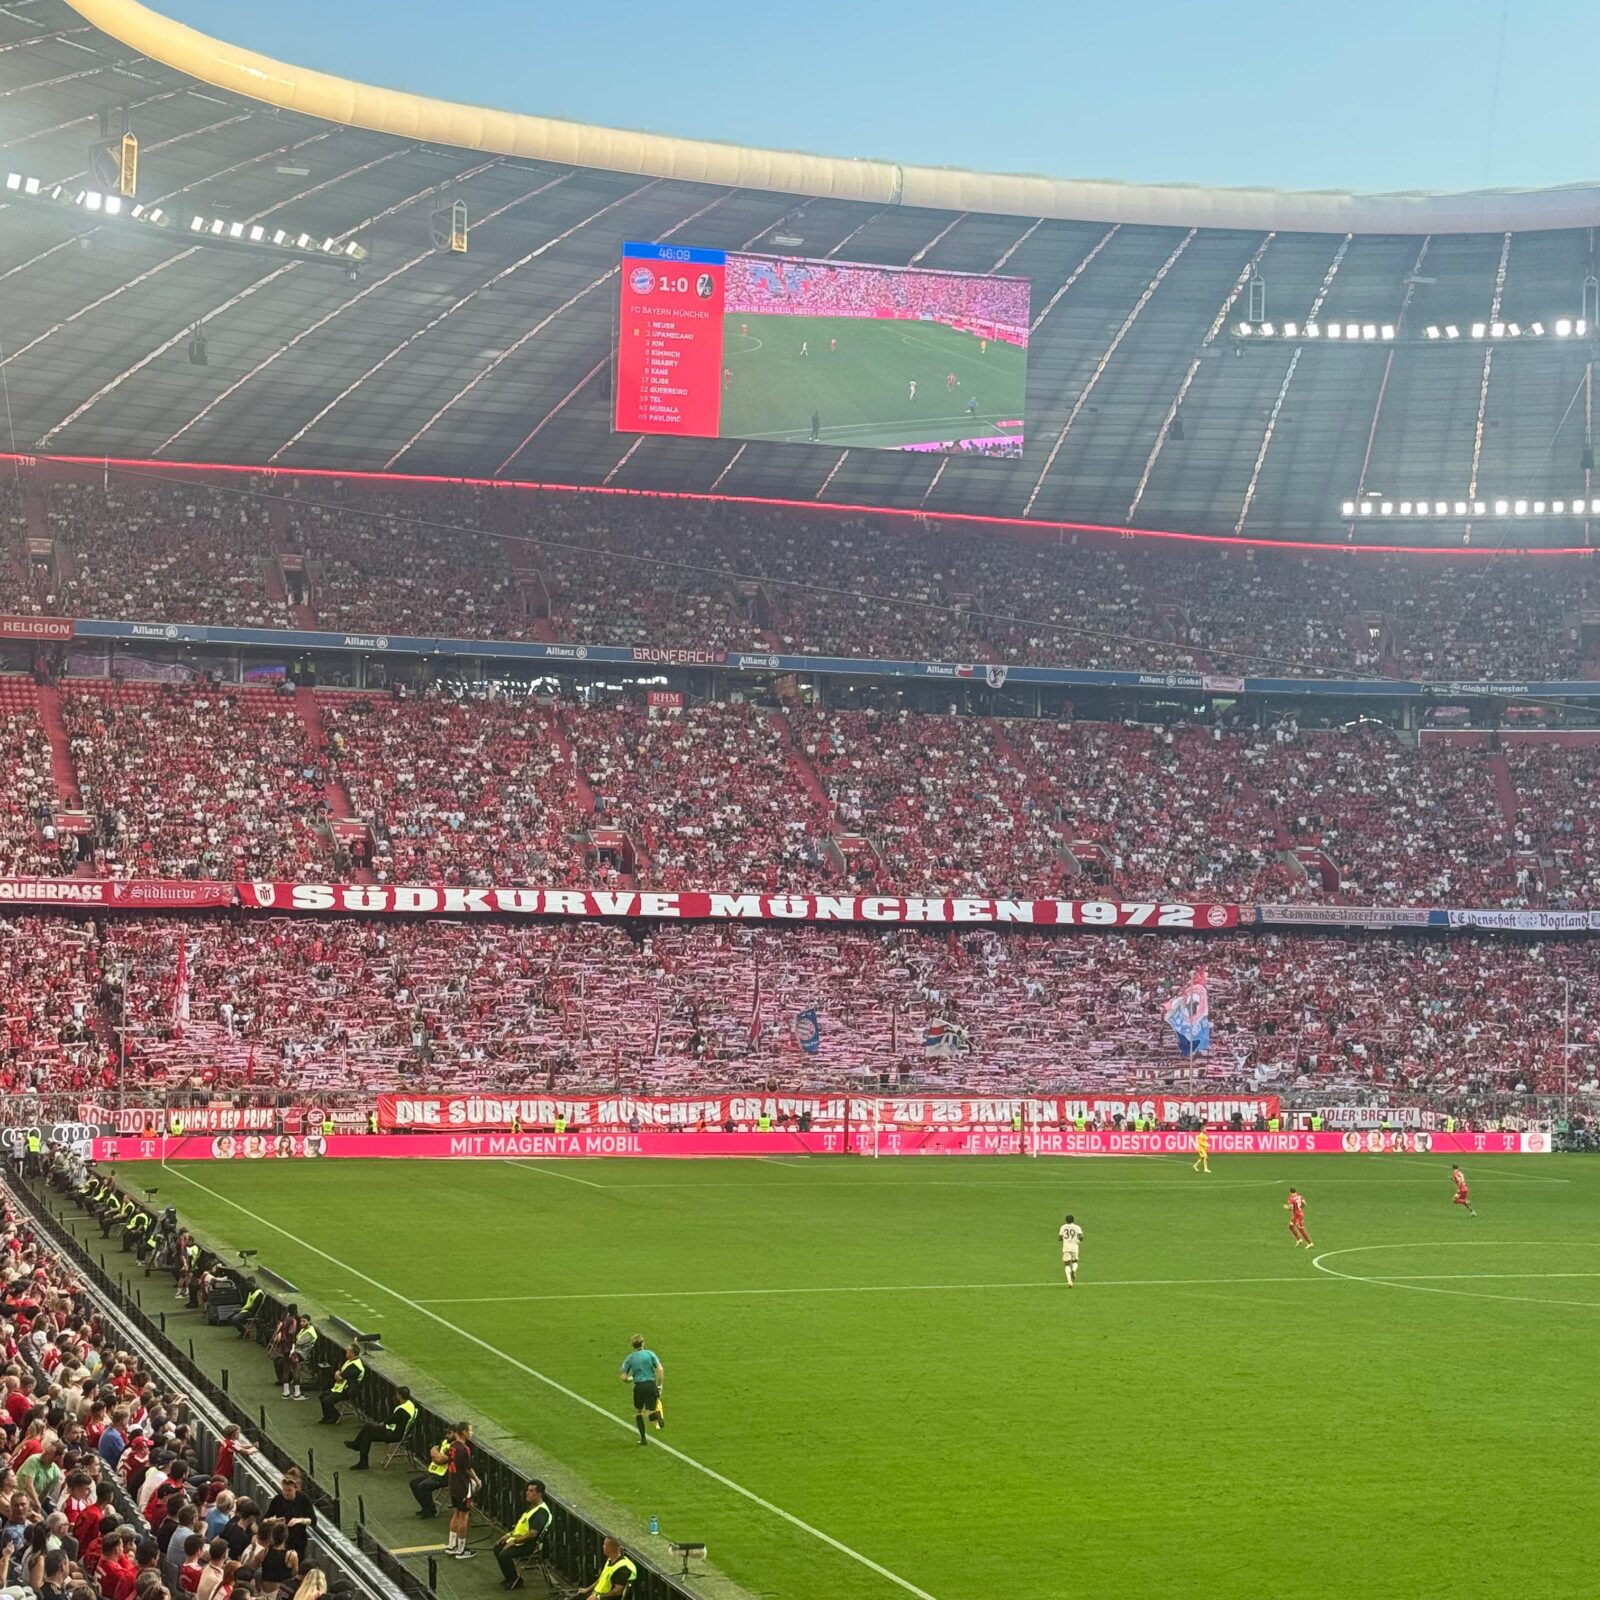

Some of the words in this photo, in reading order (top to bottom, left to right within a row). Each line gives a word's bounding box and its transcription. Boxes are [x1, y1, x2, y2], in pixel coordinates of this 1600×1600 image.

[658, 247, 691, 260] 46:09
[659, 276, 689, 293] 1:0
[630, 305, 641, 314] FC
[642, 306, 672, 316] BAYERN
[673, 309, 710, 319] MÜNCHEN
[3, 622, 70, 634] RELIGION
[132, 625, 164, 636] Allianz
[344, 637, 375, 647] Allianz
[545, 647, 575, 657] Allianz
[739, 655, 767, 666] Allianz
[926, 665, 953, 675] Allianz
[1139, 675, 1165, 685] Allianz
[1177, 676, 1202, 686] Global
[1462, 684, 1489, 693] Global
[1490, 684, 1529, 693] Investors
[653, 692, 680, 703] RHM
[0, 882, 103, 901] QUEERPASS
[130, 885, 197, 900] Südkurve
[292, 885, 681, 918] SÜDKURVE
[708, 892, 1034, 924] MÜNCHEN
[1054, 900, 1196, 928] 1972
[1539, 912, 1588, 929] Vogtland
[396, 1099, 441, 1125] DIE
[449, 1096, 590, 1125] SÜDKURVE
[598, 1097, 722, 1126] MÜNCHEN
[894, 1102, 925, 1122] ZU
[932, 1102, 963, 1123] 25
[1066, 1100, 1156, 1123] ULTRAS
[1319, 1108, 1356, 1122] ADLER
[1360, 1109, 1415, 1122] BRETTEN
[220, 1110, 241, 1129] RED
[243, 1109, 274, 1129] PRIDE
[450, 1136, 485, 1155] MIT
[490, 1135, 580, 1154] MAGENTA
[586, 1135, 643, 1153] MOBIL
[962, 1135, 980, 1149] JE
[984, 1135, 1031, 1150] MEHR
[1036, 1134, 1062, 1150] IHR
[1069, 1134, 1107, 1153] SEID,
[1111, 1134, 1162, 1151] DESTO
[1165, 1132, 1254, 1151] GÜNTIGER
[1063, 1228, 1076, 1240] 39
